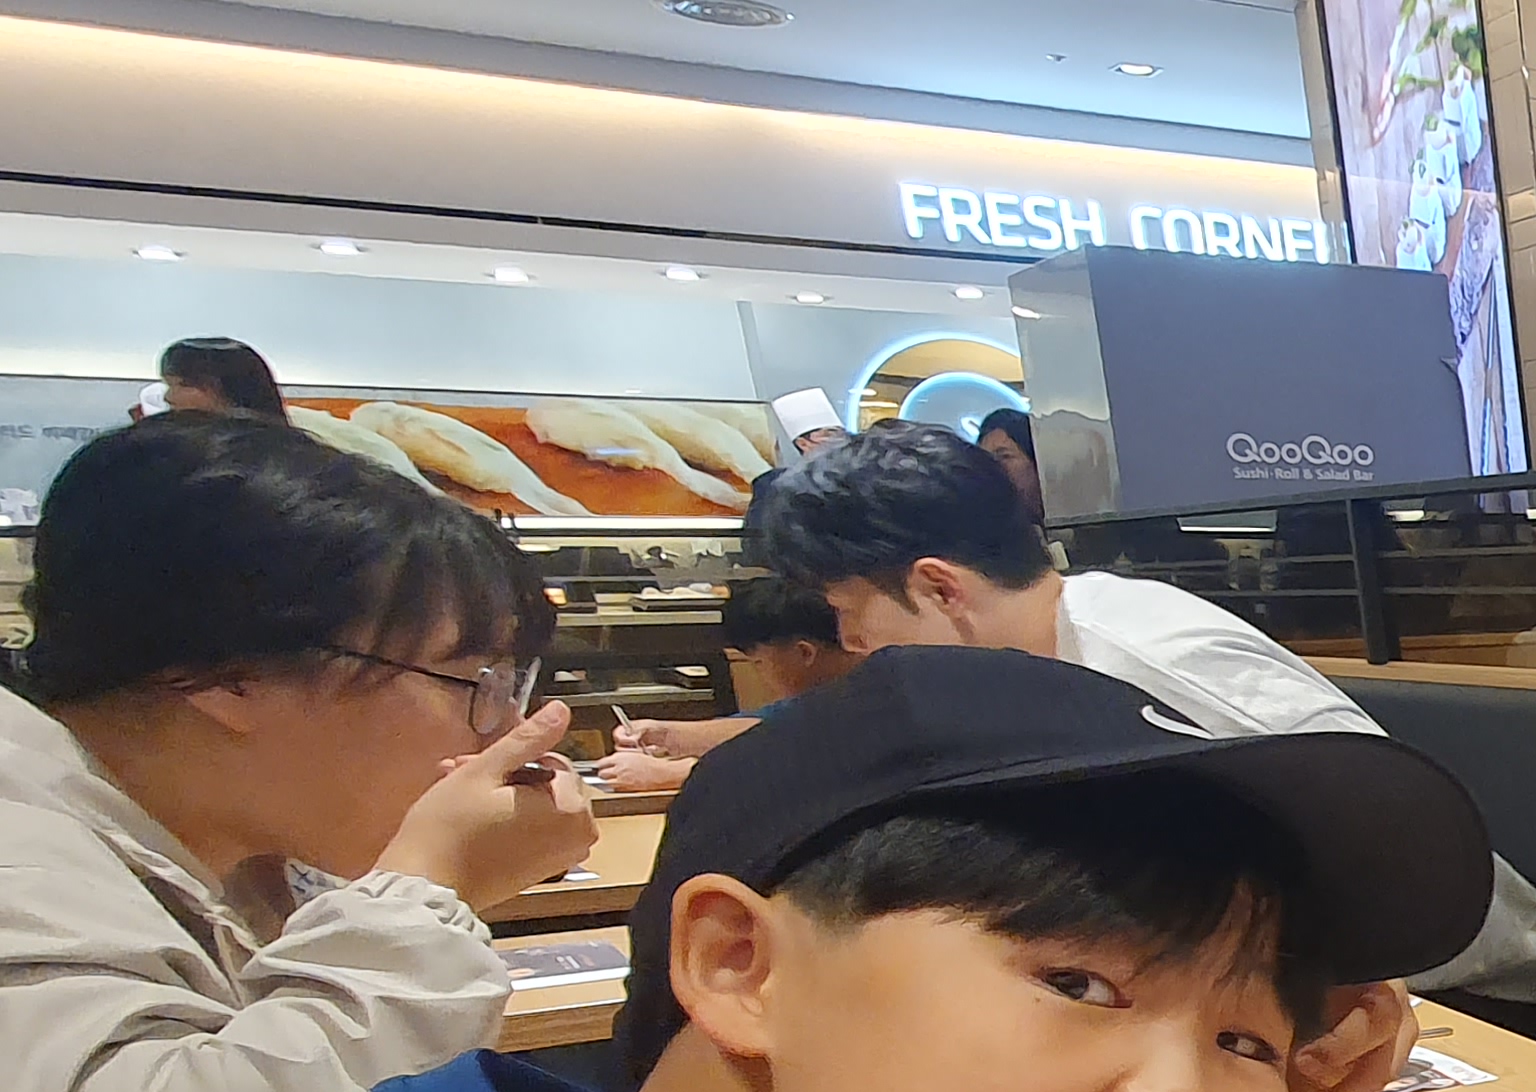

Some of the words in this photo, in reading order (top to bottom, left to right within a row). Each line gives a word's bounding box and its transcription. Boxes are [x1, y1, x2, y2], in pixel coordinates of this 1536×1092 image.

[899, 182, 1107, 250] FRESH
[1226, 432, 1374, 465] QooQoo
[1317, 468, 1350, 481] Salad
[1353, 469, 1374, 481] Bar
